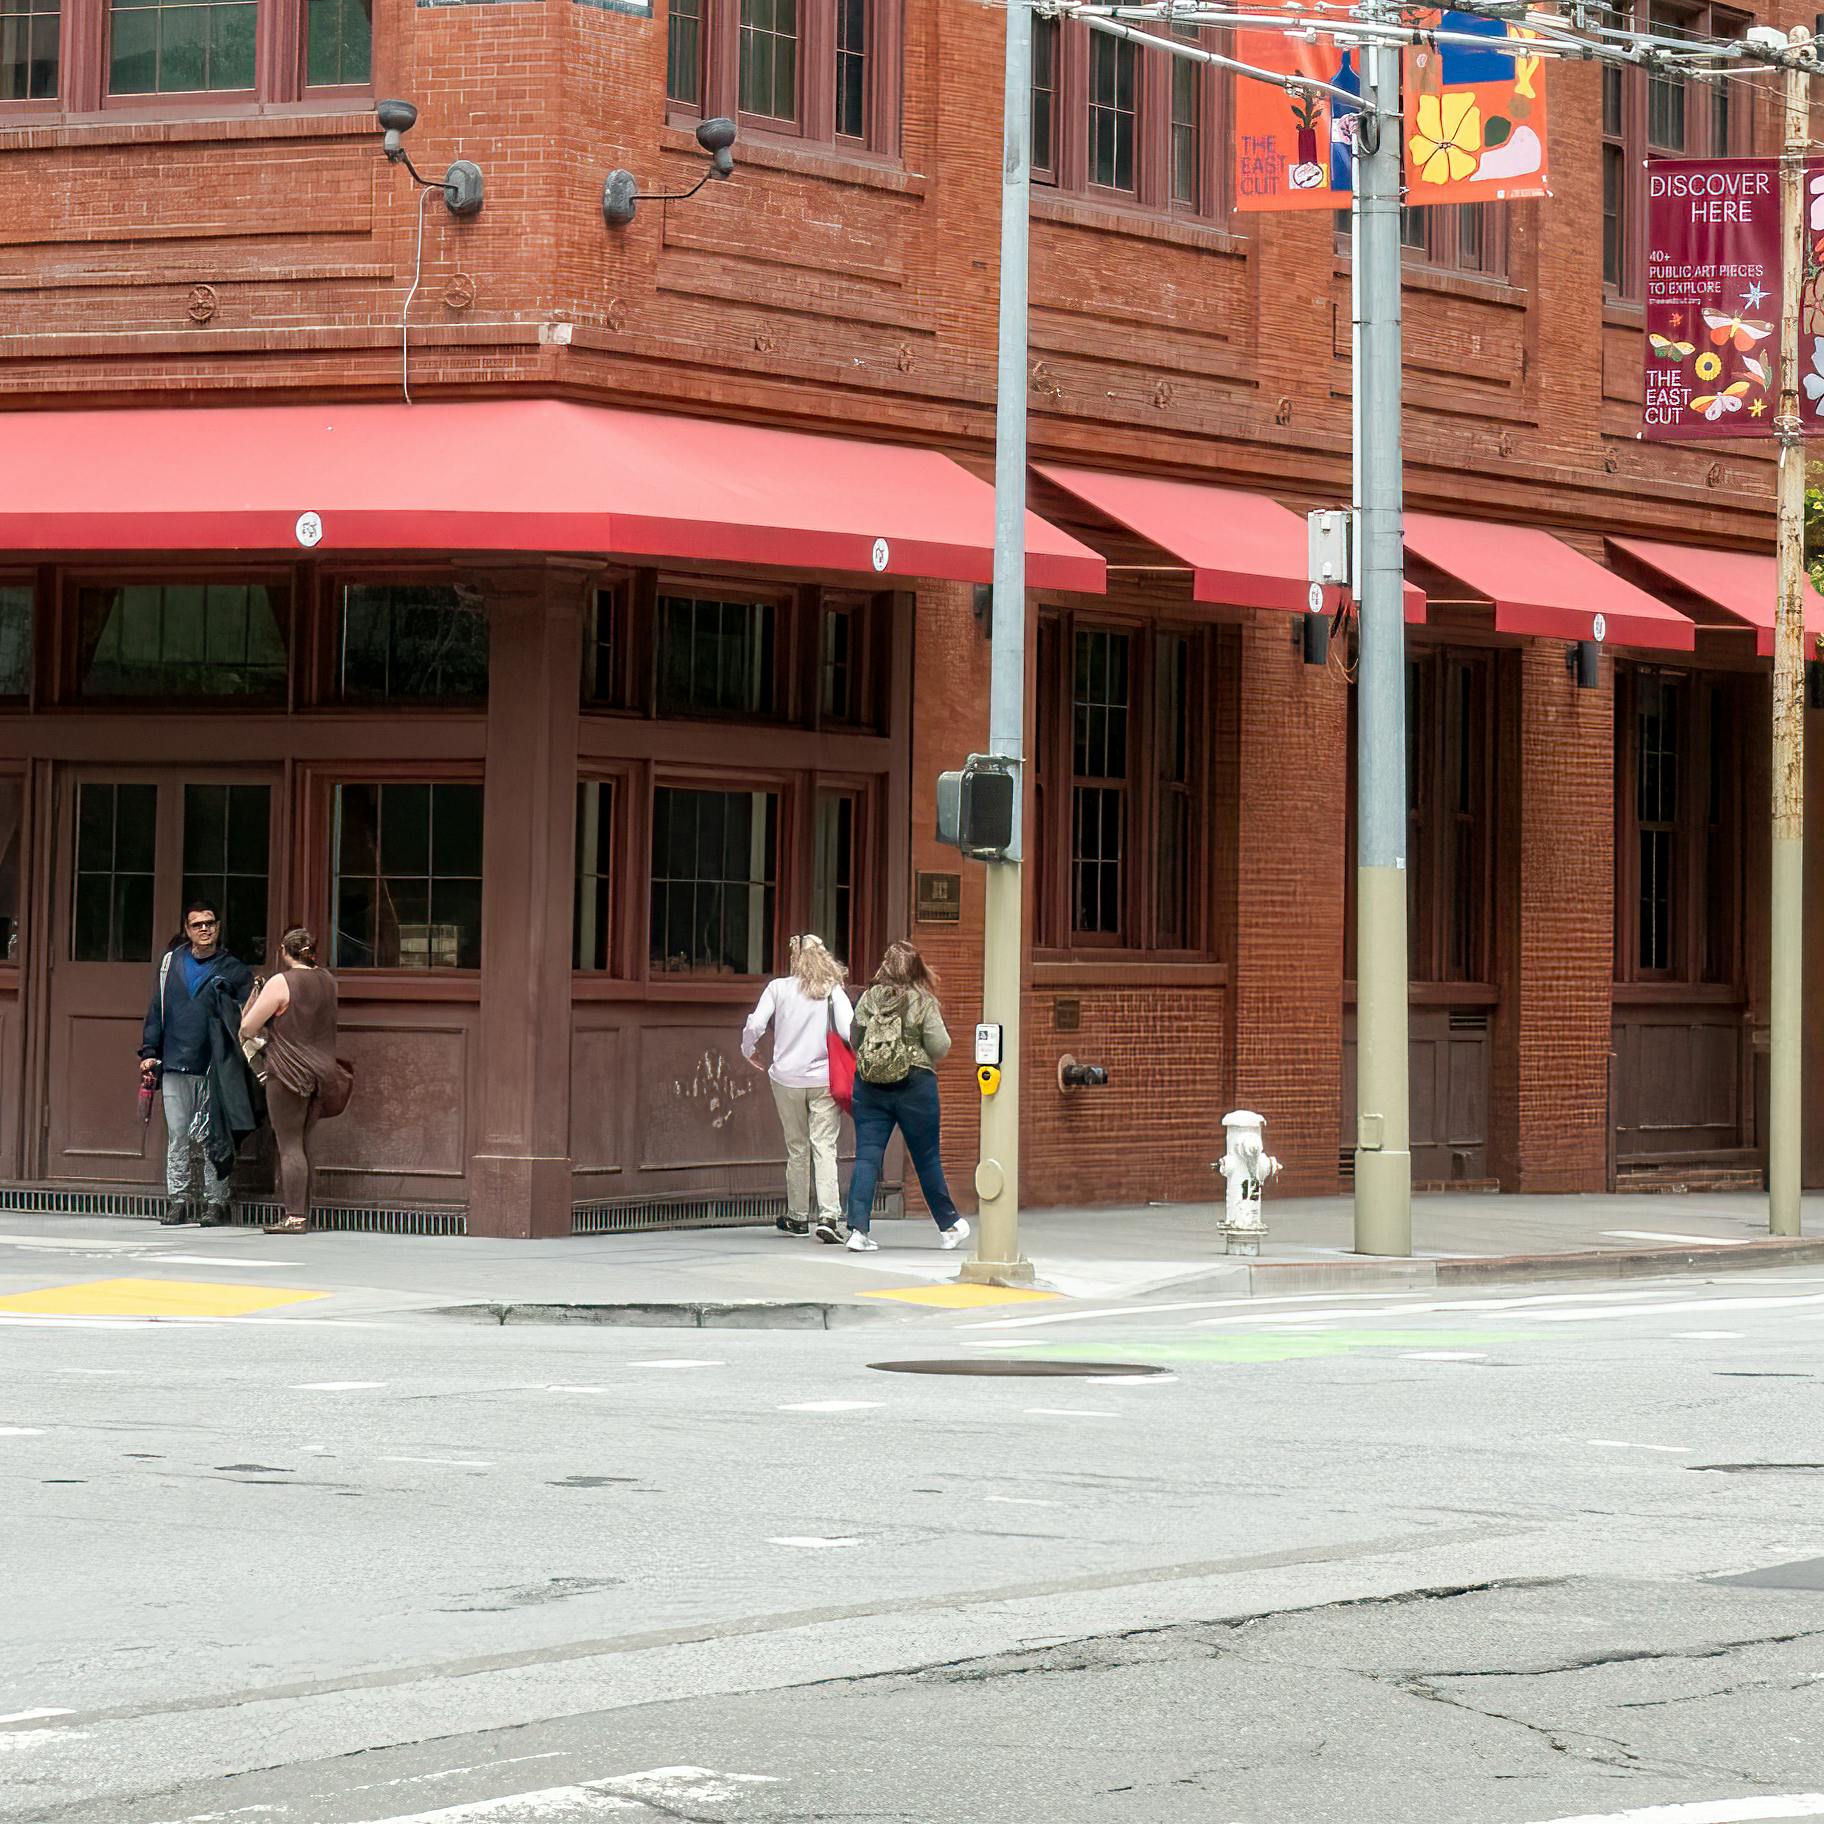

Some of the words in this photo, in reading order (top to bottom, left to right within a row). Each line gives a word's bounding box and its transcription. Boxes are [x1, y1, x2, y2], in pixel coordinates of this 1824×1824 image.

[1241, 135, 1277, 157] THE
[1241, 155, 1287, 175] EAST
[1241, 176, 1280, 195] CUT
[1650, 173, 1771, 197] DISCOVER
[1691, 201, 1753, 223] HERE
[1649, 250, 1671, 263] 40+
[1649, 265, 1691, 279] PUBLIC
[1694, 264, 1717, 278] ART
[1719, 264, 1764, 277] PIECES
[1649, 282, 1665, 295] TO
[1668, 281, 1722, 295] EXPLORE
[1646, 370, 1682, 387] THE
[1646, 388, 1692, 406] EAST
[1645, 407, 1683, 424] CUT
